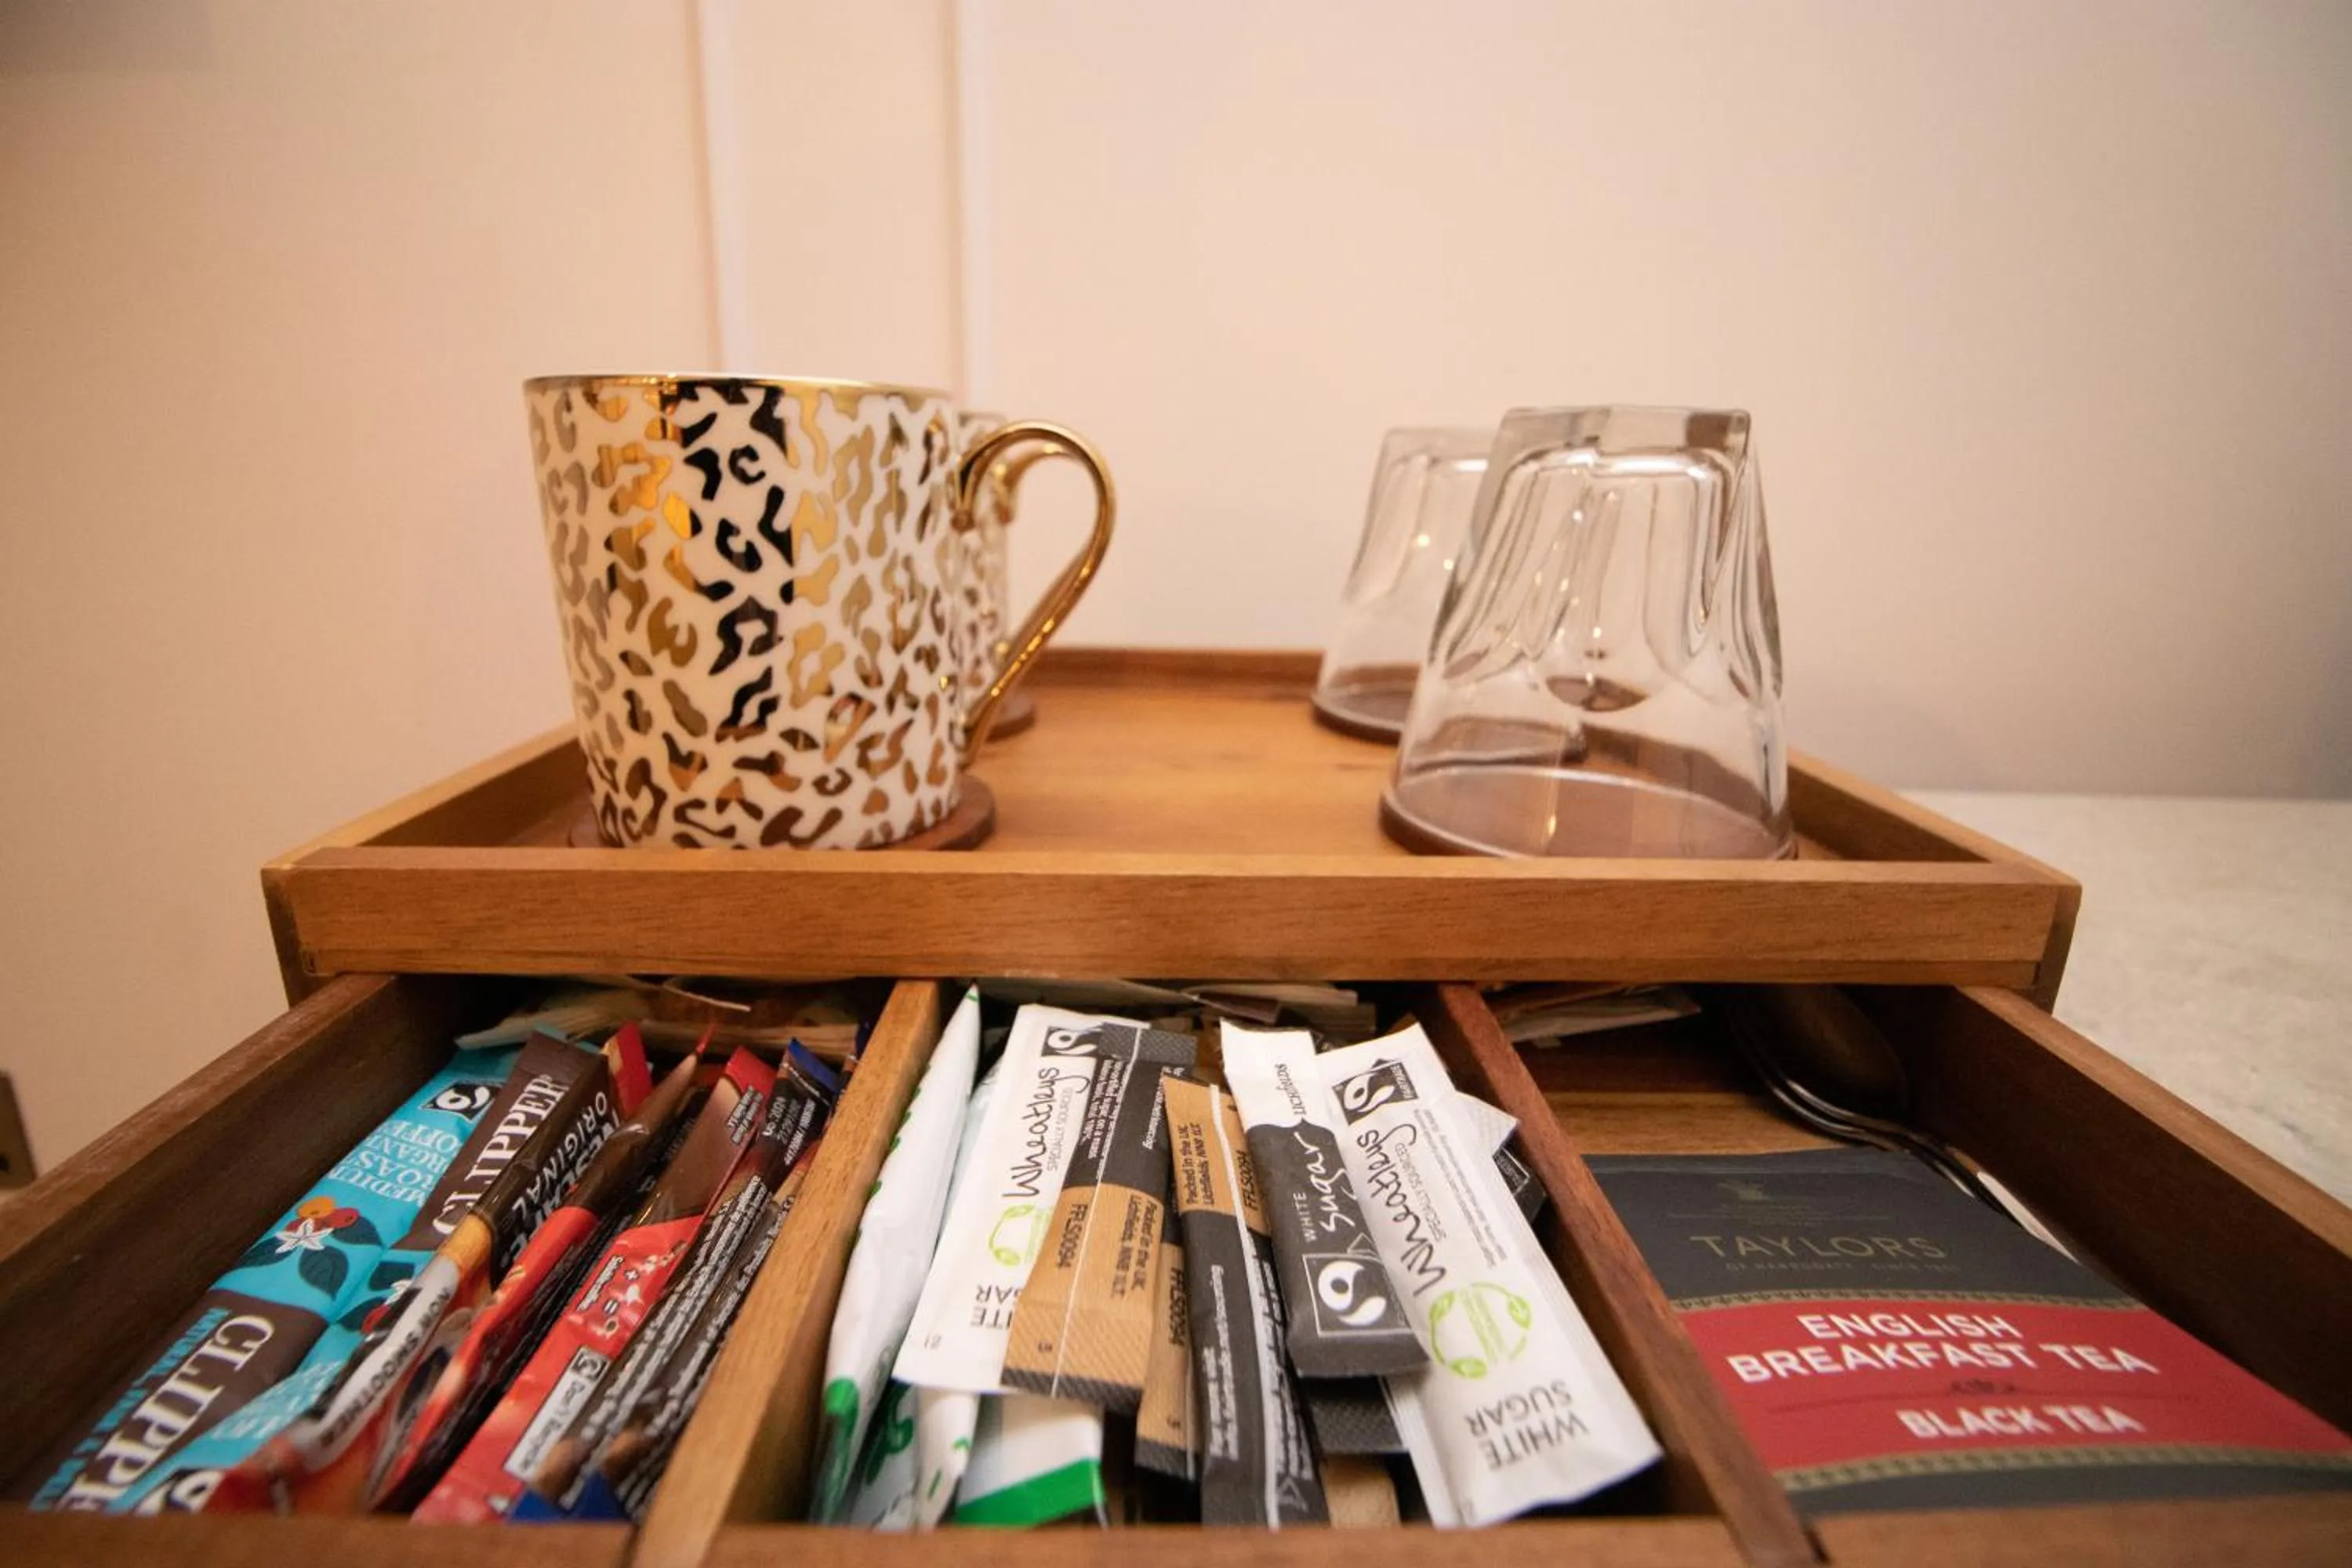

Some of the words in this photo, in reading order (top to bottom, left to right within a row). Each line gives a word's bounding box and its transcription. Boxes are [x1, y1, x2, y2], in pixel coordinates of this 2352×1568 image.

[433, 1074, 570, 1234] CLIPPER
[512, 1091, 608, 1221] ORIGINAL
[1002, 1067, 1091, 1197] Wheatleys
[1294, 1192, 1317, 1243] WHITE
[1356, 1123, 1446, 1297] Wheatleys
[1690, 1236, 1946, 1258] TAYLORS
[970, 1307, 1013, 1330] ITE
[1798, 1313, 2023, 1339] ENGLISH
[1726, 1342, 2038, 1384] BREAKFAST
[2042, 1343, 2160, 1375] TEA
[1464, 1380, 1573, 1438] SUGAR
[1897, 1409, 2053, 1439] BLACK
[2044, 1406, 2146, 1435] TEA
[1479, 1410, 1591, 1473] WHITE
